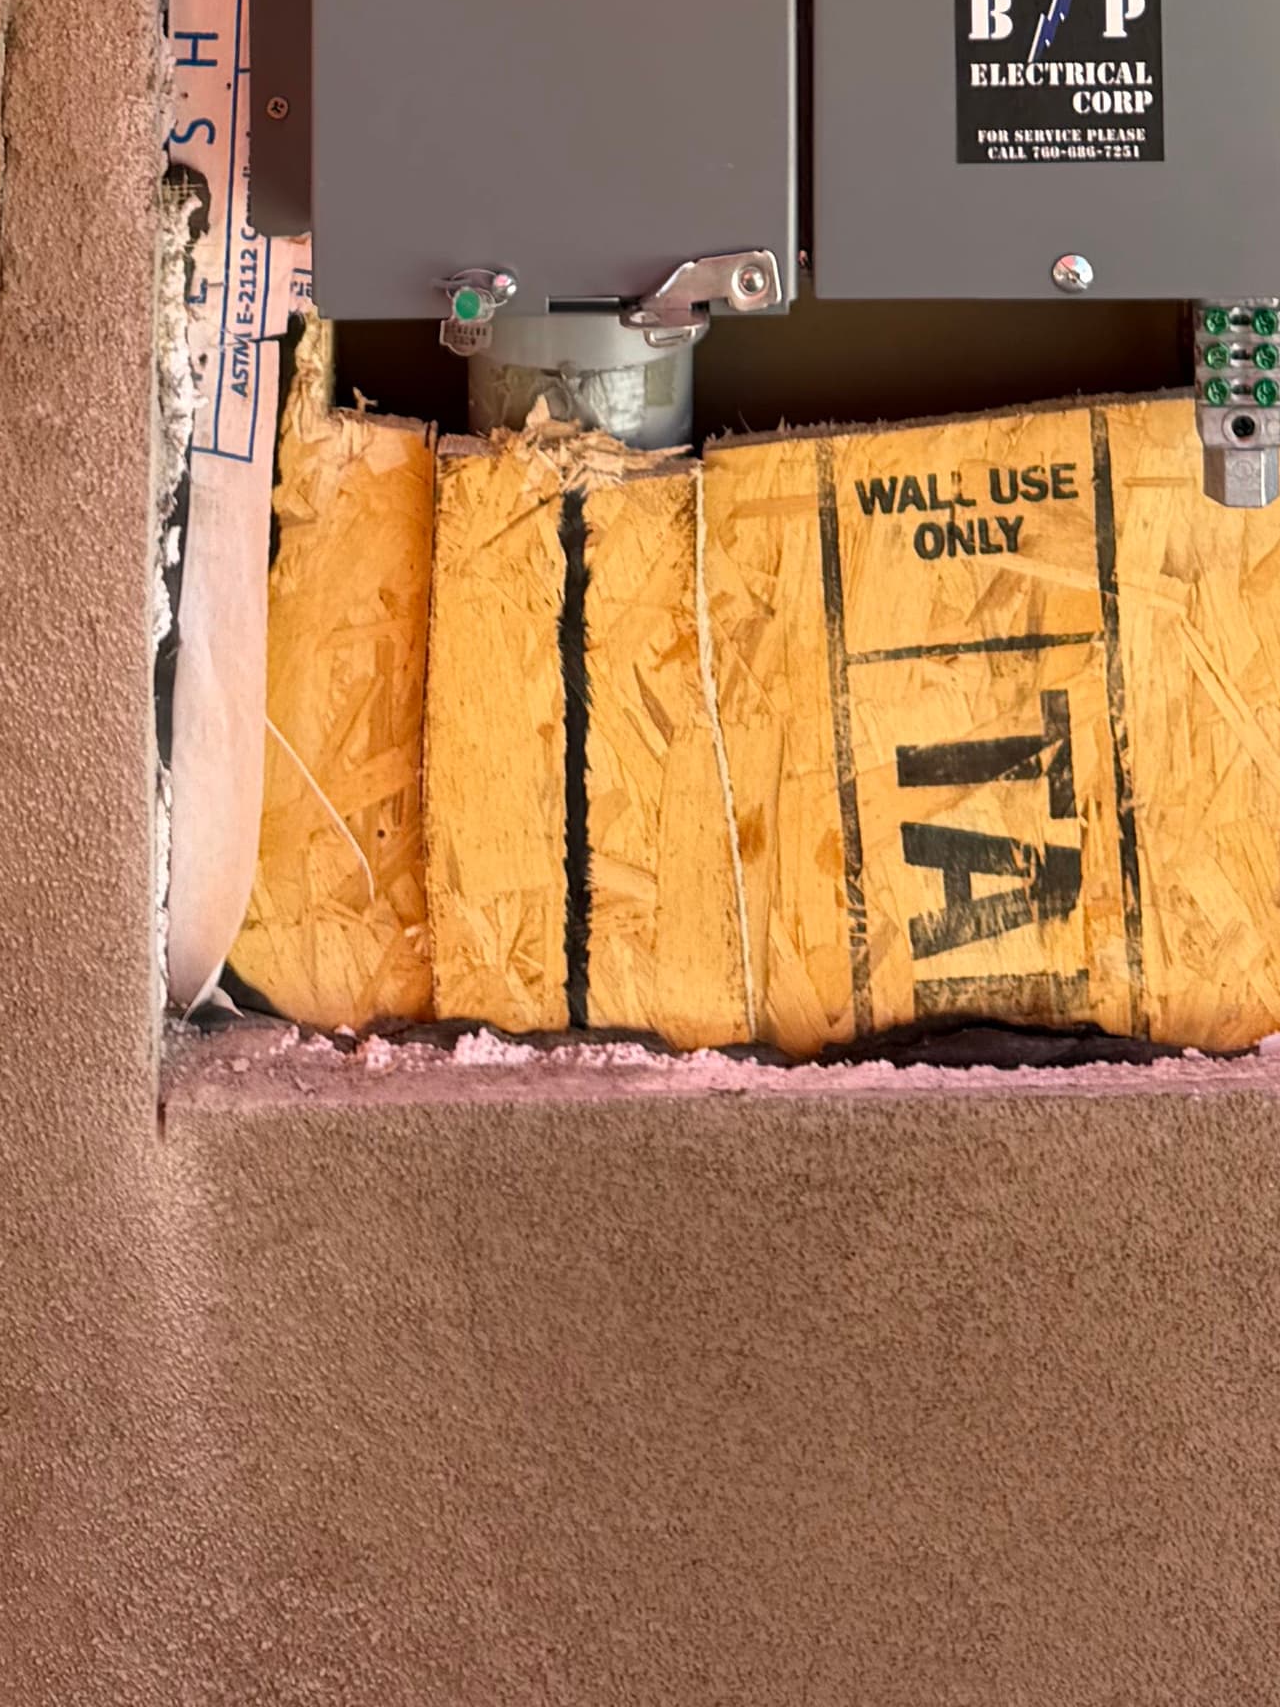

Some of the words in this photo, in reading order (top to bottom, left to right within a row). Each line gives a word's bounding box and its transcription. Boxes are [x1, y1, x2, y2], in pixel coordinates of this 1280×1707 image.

[970, 62, 1153, 87] ELECTRICAL
[1072, 90, 1154, 114] CORP
[977, 130, 1010, 143] FOR
[1014, 129, 1082, 143] SERVICE
[1086, 128, 1147, 142] PLEASE
[987, 146, 1027, 160] CALL
[235, 248, 257, 325] E-2112
[230, 332, 252, 397] ASTM
[854, 470, 977, 516] WALL
[989, 462, 1080, 505] USE
[914, 514, 1025, 561] ONLY
